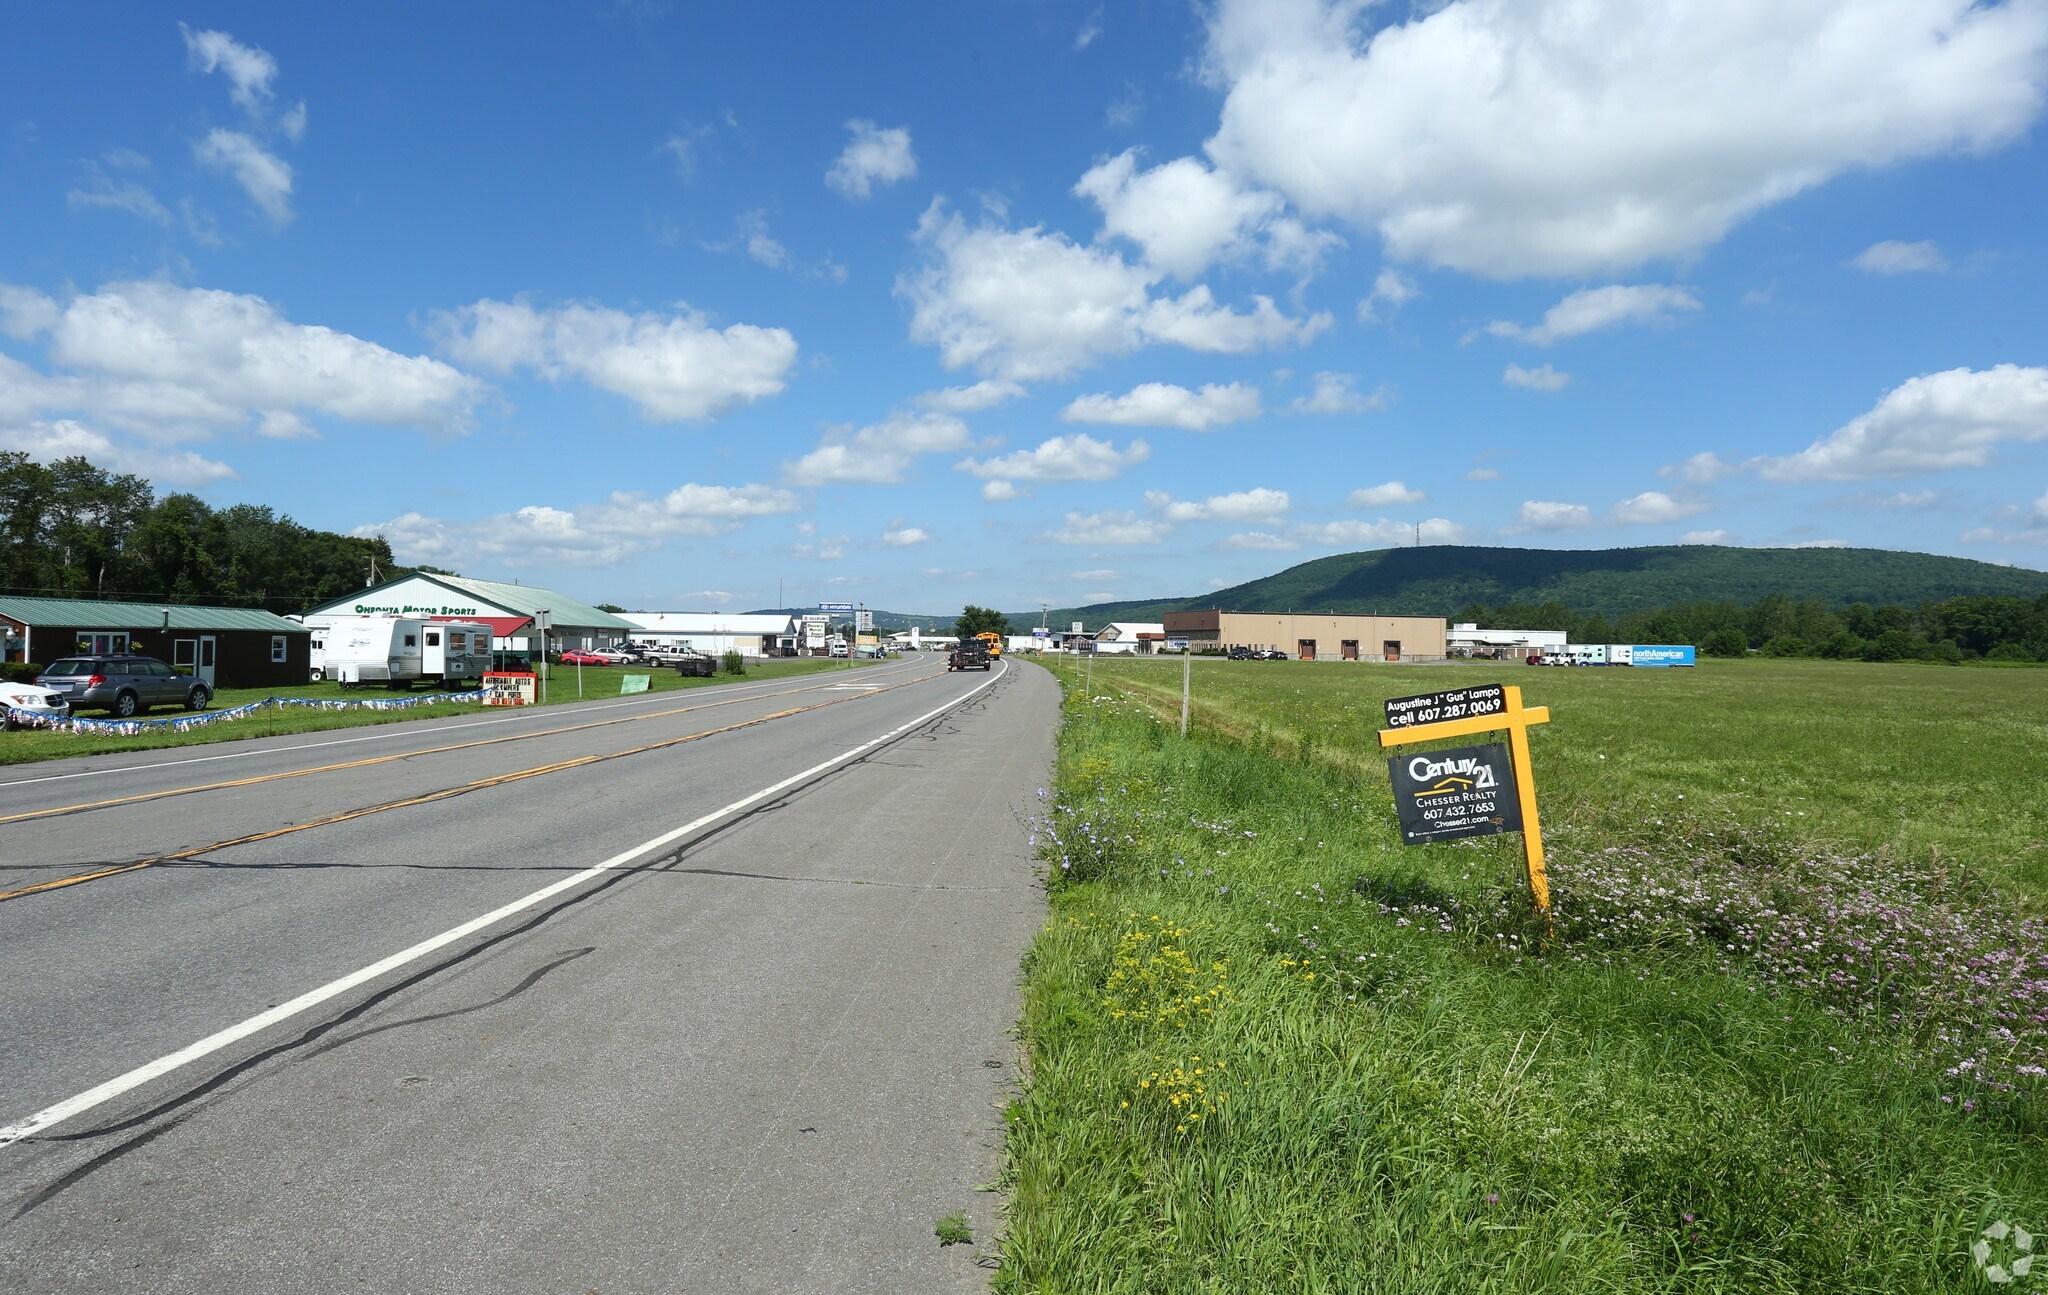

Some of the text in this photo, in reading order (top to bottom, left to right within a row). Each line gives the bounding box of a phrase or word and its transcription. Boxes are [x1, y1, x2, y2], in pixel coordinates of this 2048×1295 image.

[441, 606, 476, 616] SPORTS
[1634, 650, 1684, 658] northAmerican
[1387, 697, 1432, 712] Augustine
[1469, 687, 1500, 701] Lampo
[1390, 698, 1500, 726] cell 607.287.0069
[1409, 757, 1477, 782] Century
[1416, 790, 1497, 808] CHESSER REALTY
[1423, 802, 1496, 820] 607.432.7653
